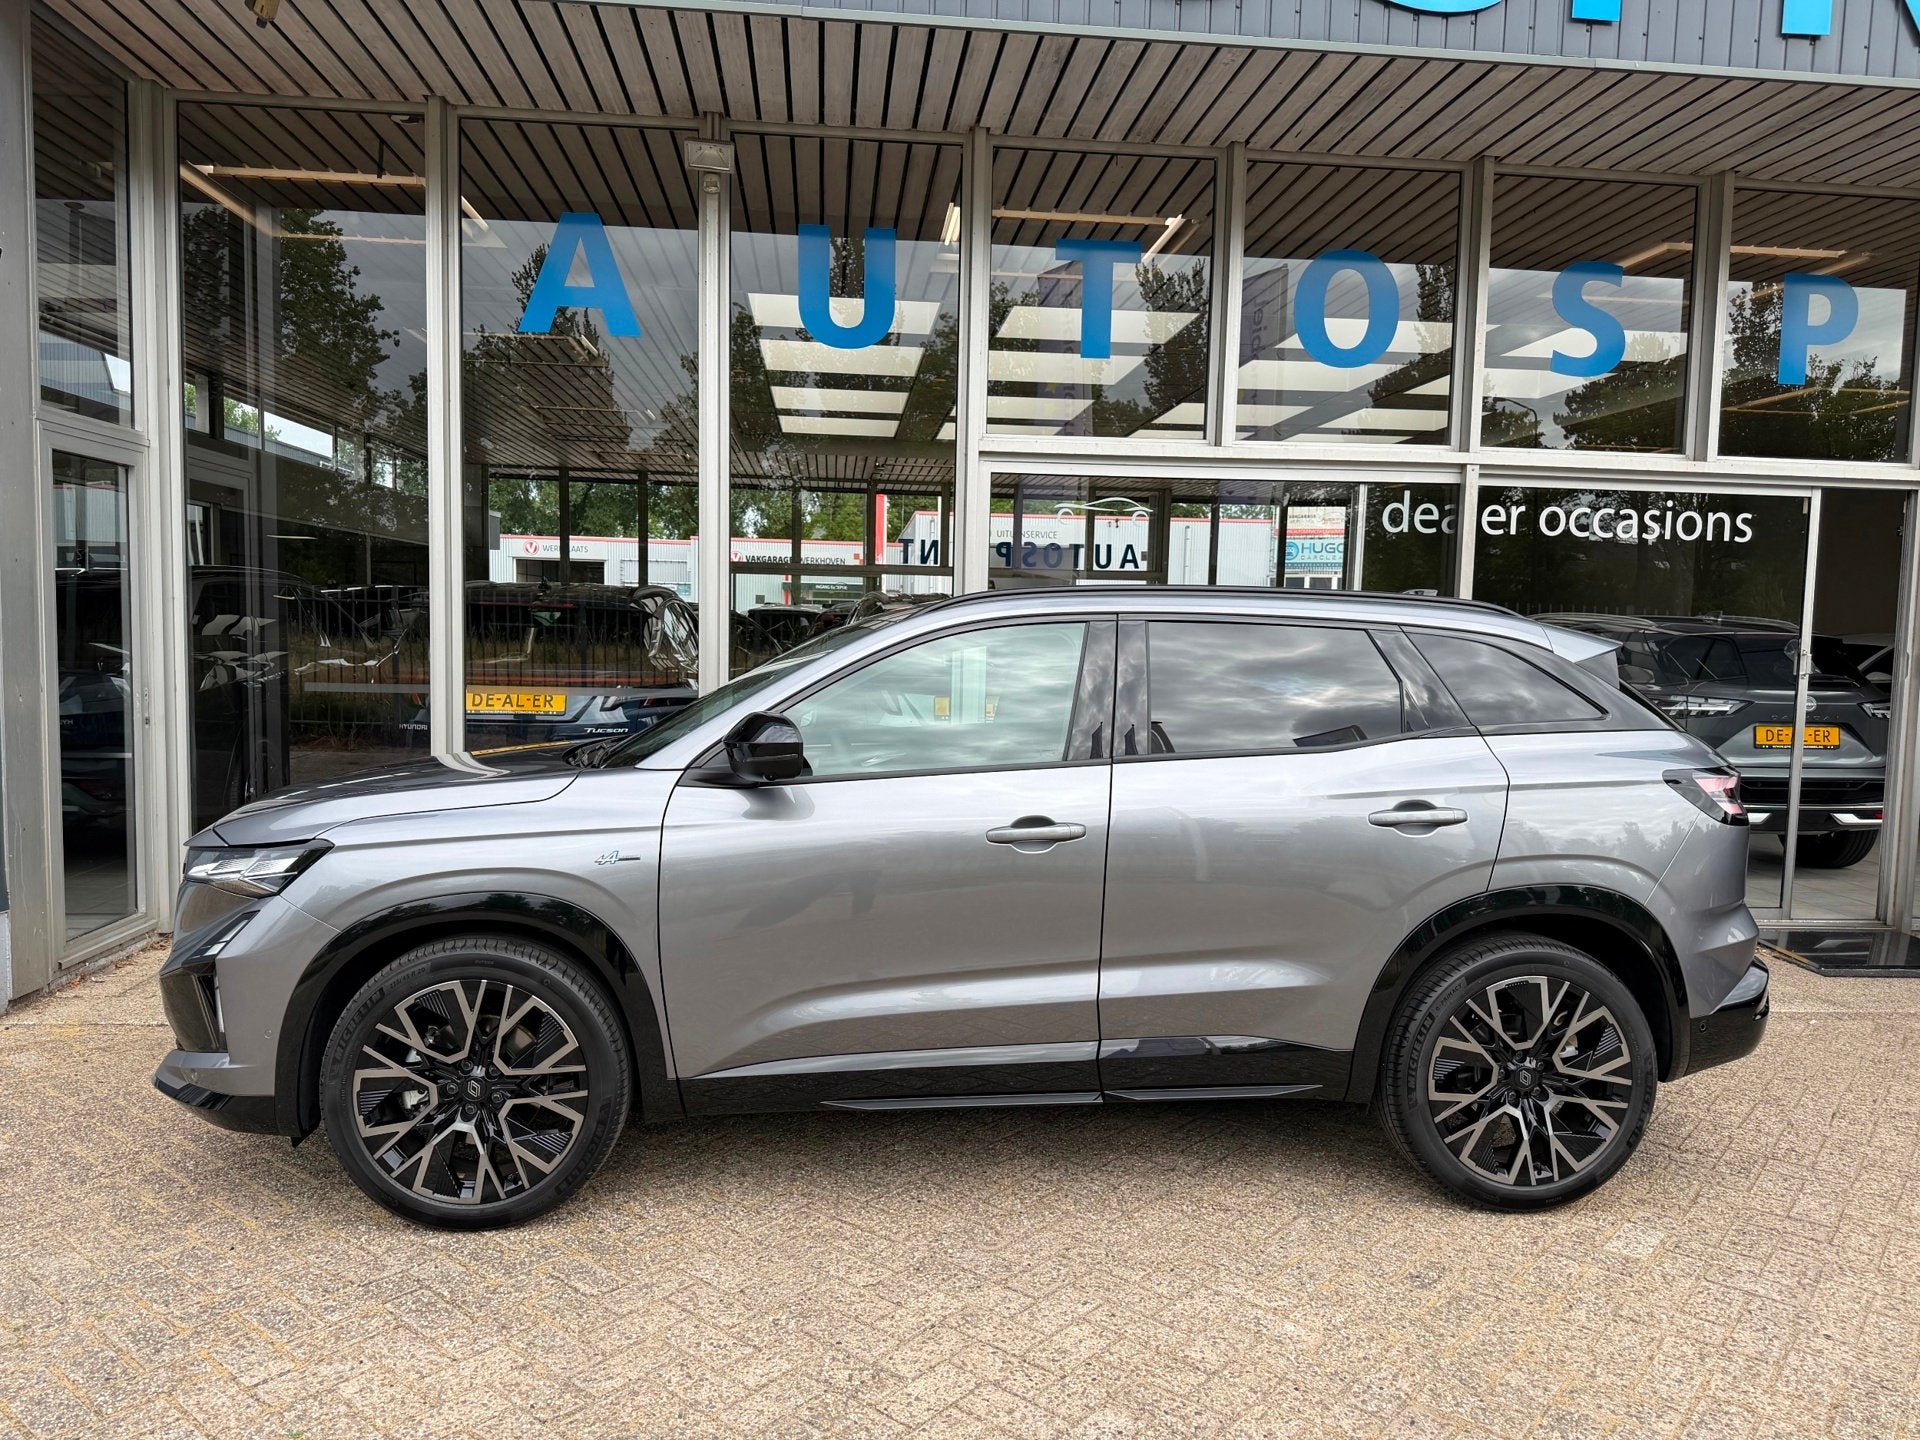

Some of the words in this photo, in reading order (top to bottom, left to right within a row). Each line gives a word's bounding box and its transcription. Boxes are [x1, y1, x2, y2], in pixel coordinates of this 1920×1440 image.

[1382, 490, 1525, 536] deaer
[1539, 500, 1753, 544] occasions
[542, 544, 589, 553] WERAATS
[472, 693, 554, 708] DE-AL-ER
[1765, 729, 1831, 743] DE--ER
[1406, 1015, 1434, 1090] MICHELIN
